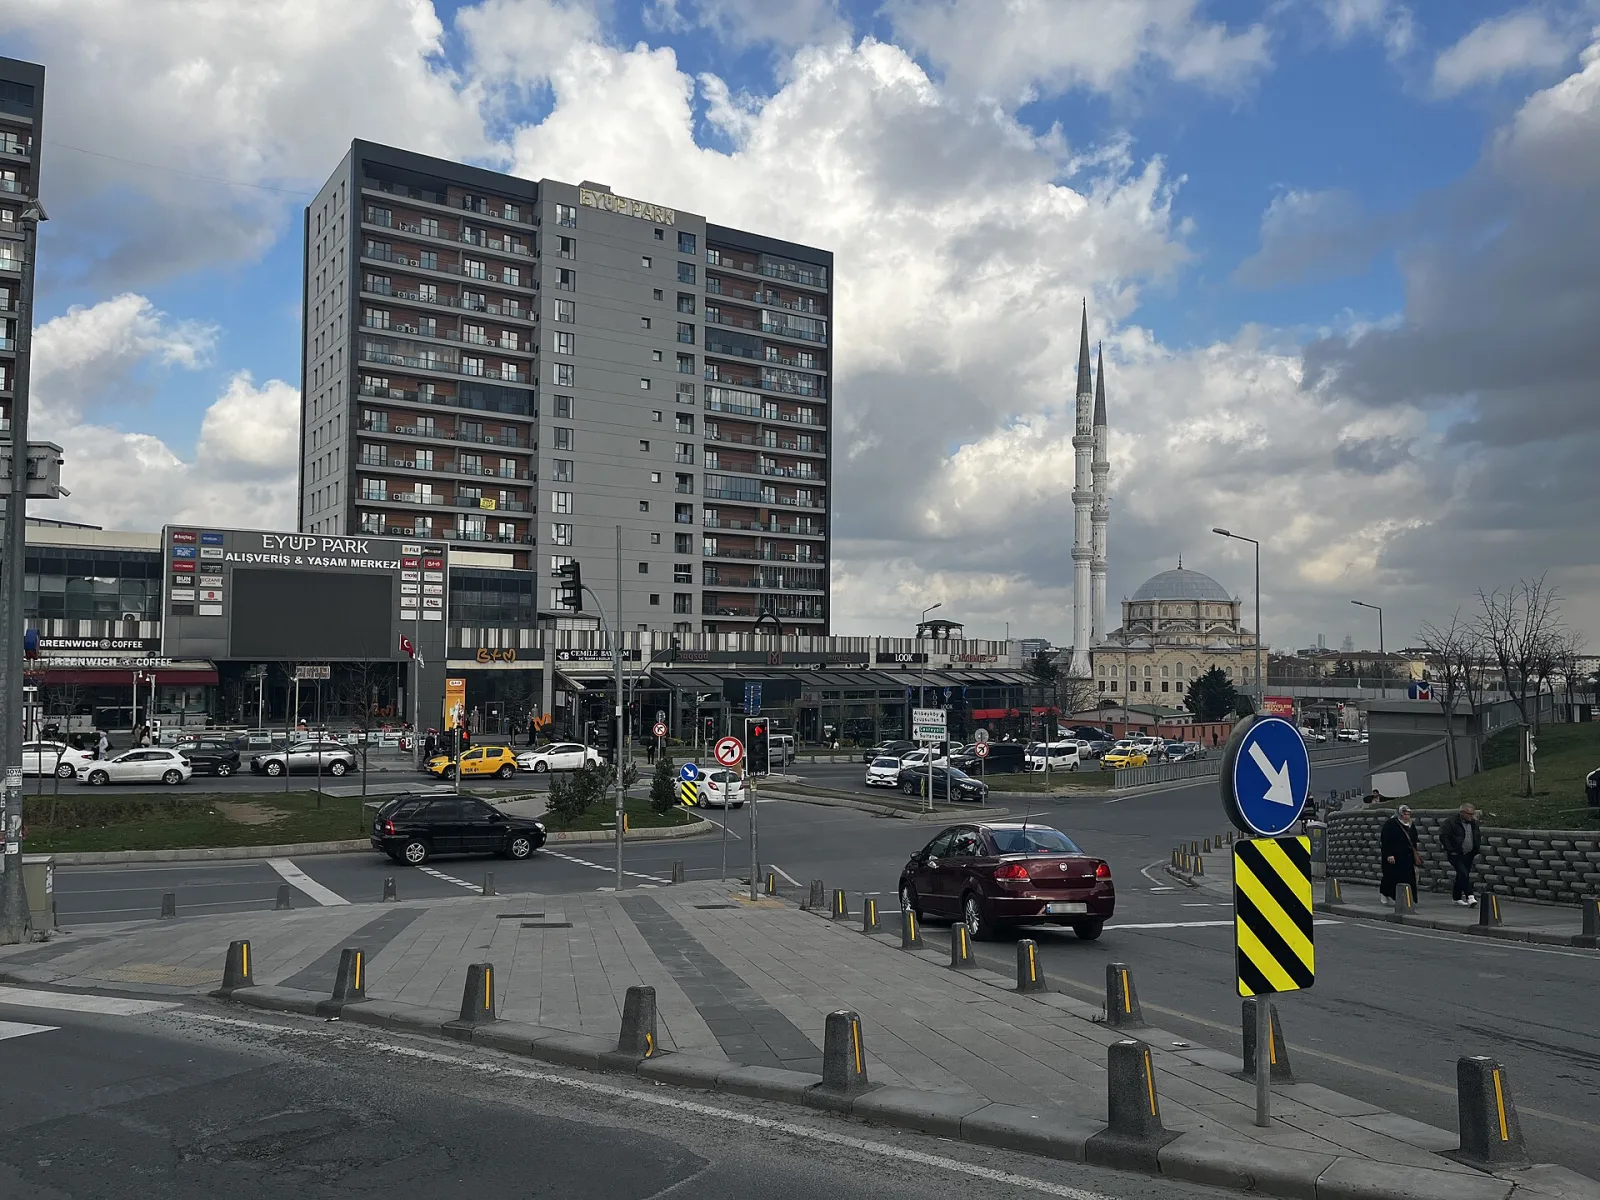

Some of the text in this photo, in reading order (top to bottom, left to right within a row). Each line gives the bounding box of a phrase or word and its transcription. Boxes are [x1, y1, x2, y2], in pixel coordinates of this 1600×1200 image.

[580, 187, 676, 227] EYÜP PARK
[262, 534, 369, 554] EYÜP PARK
[225, 552, 291, 566] ALIŞVERİŞ
[294, 556, 303, 565] &
[307, 556, 347, 567] YAŞAM
[350, 559, 401, 570] MERKEZİ
[39, 639, 143, 648] GREENWICH COFFEE
[136, 658, 173, 667] COFFEE
[895, 653, 913, 662] LOOK
